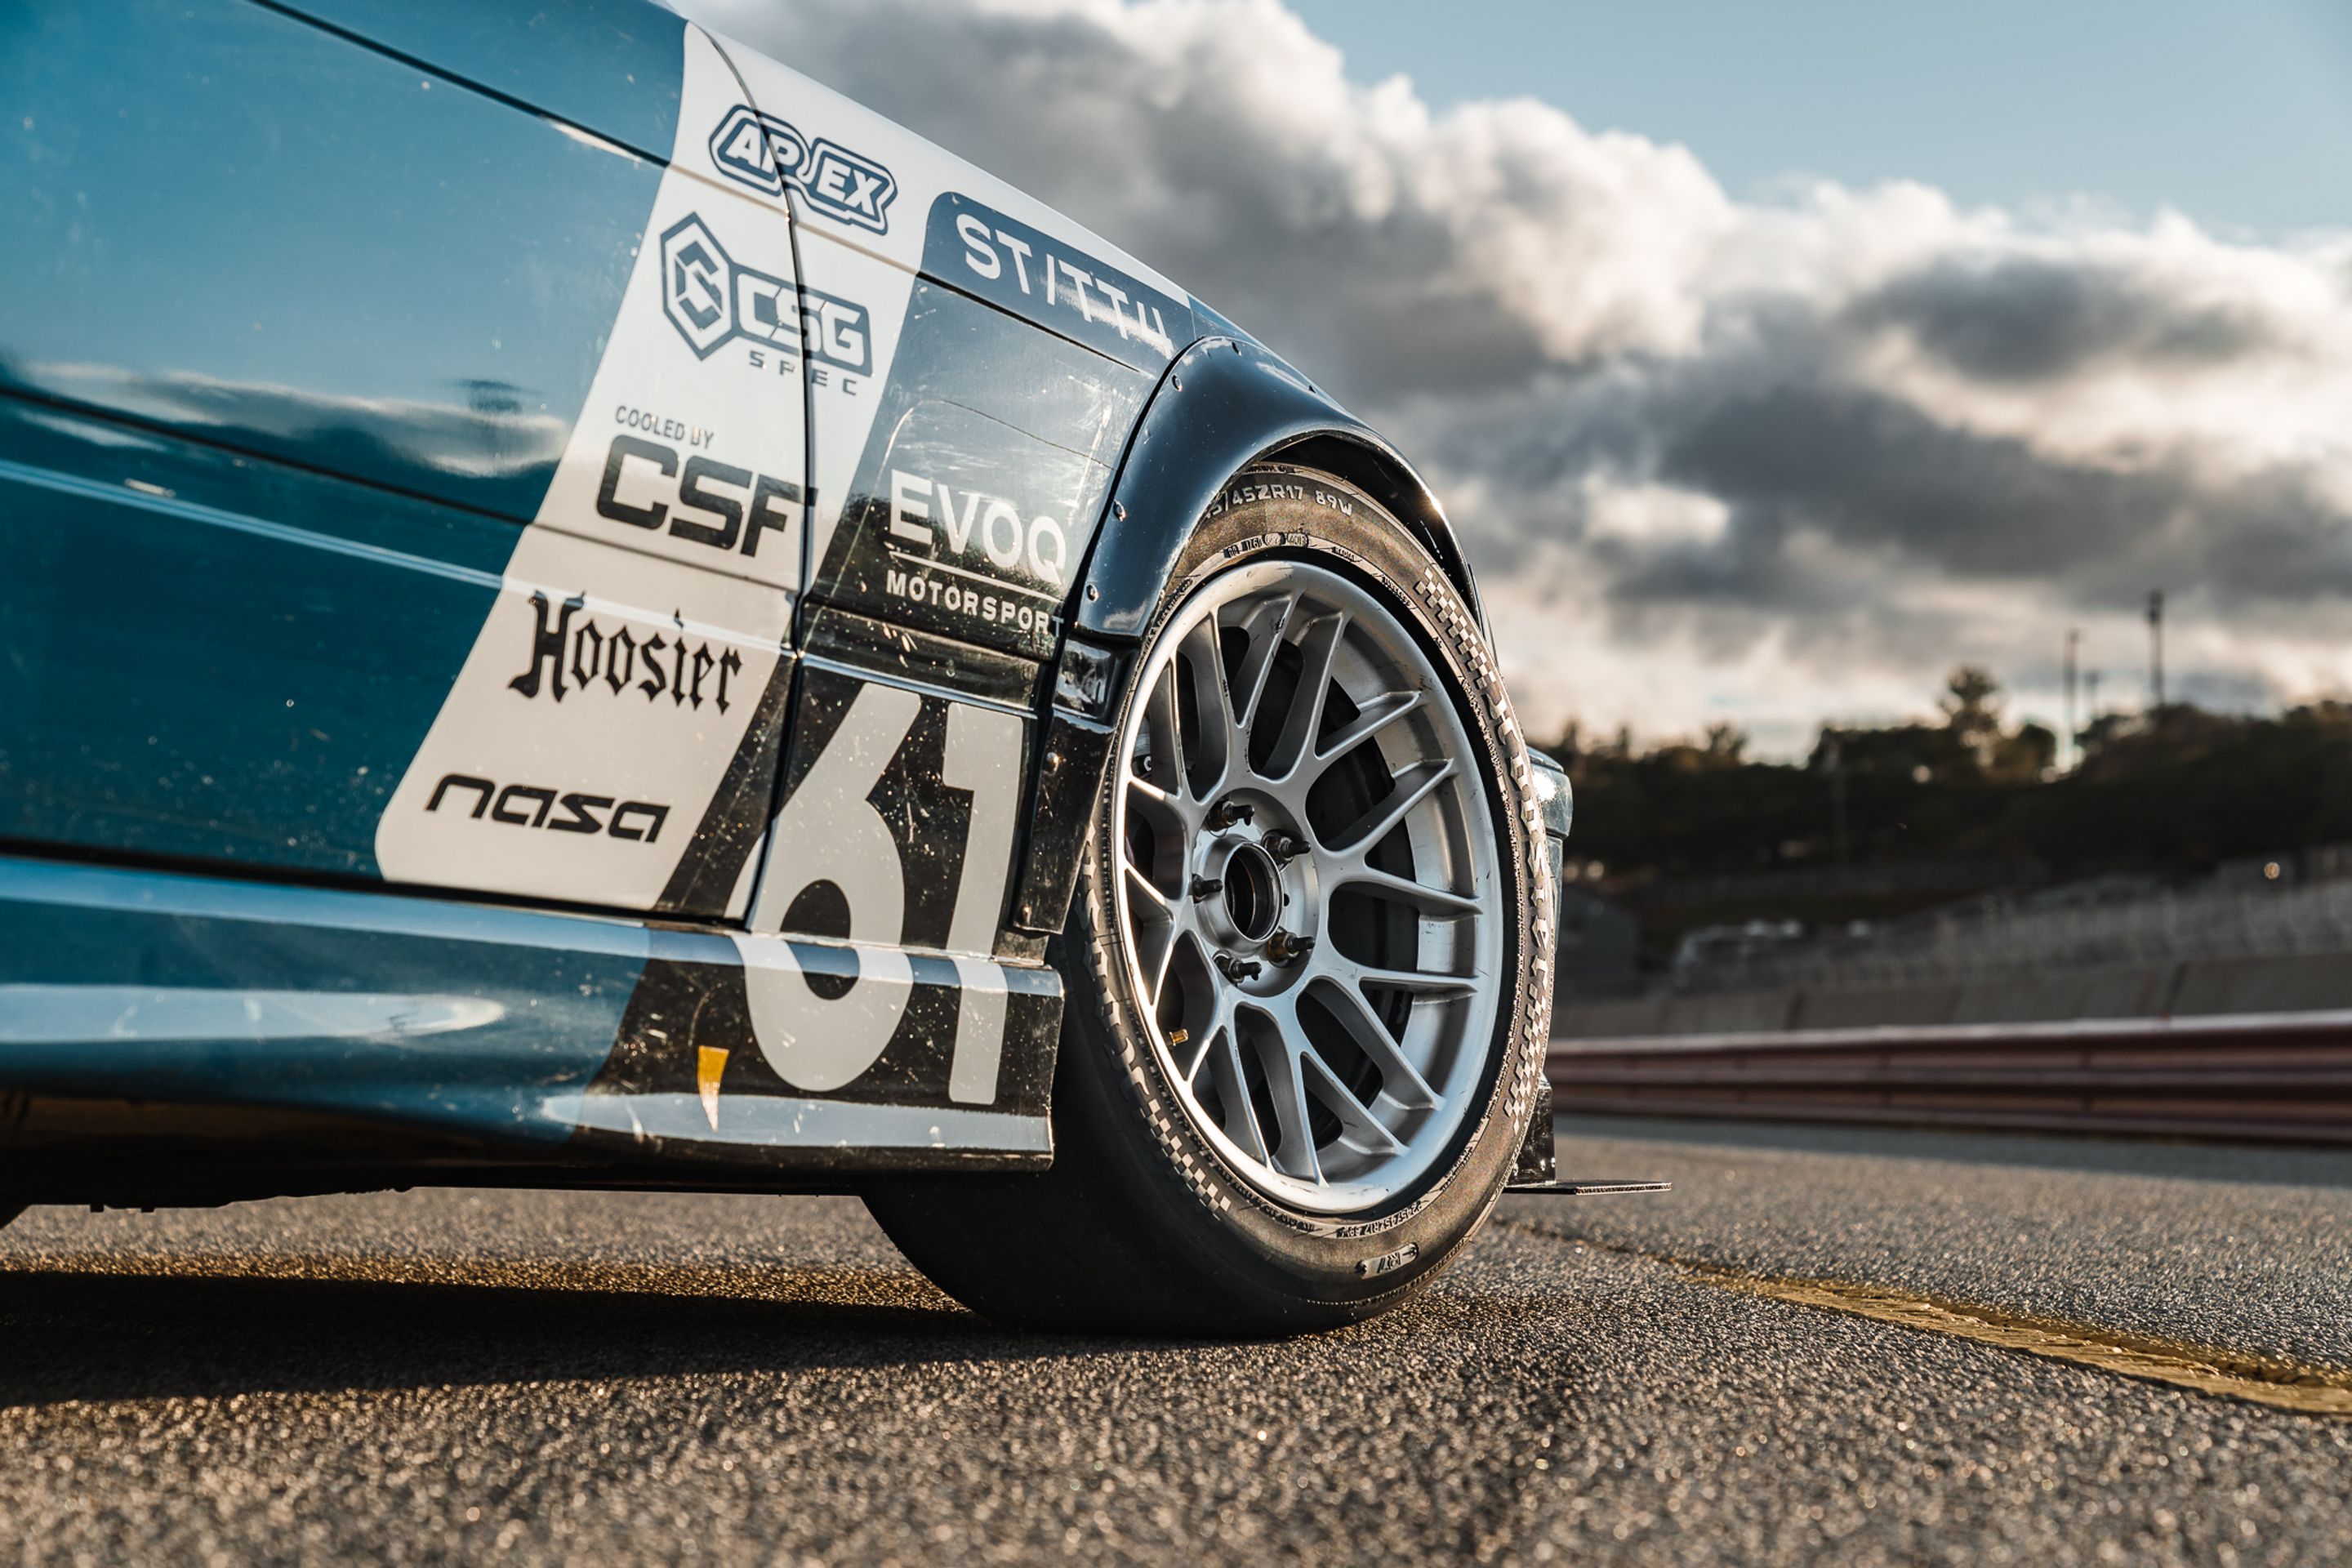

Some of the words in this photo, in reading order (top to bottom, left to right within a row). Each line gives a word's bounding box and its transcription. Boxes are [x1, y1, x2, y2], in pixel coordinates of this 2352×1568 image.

[722, 121, 893, 220] APEX
[738, 272, 866, 368] CSG
[750, 350, 857, 396] SPEC
[615, 405, 685, 441] COOLED
[595, 434, 818, 558] CSF
[889, 469, 1067, 586] EVOQ
[1315, 490, 1352, 516] 89W
[886, 569, 1065, 638] MOTORSPORT
[508, 590, 744, 715] Hoosier
[425, 773, 671, 843] nasa
[724, 681, 1023, 1106] 61
